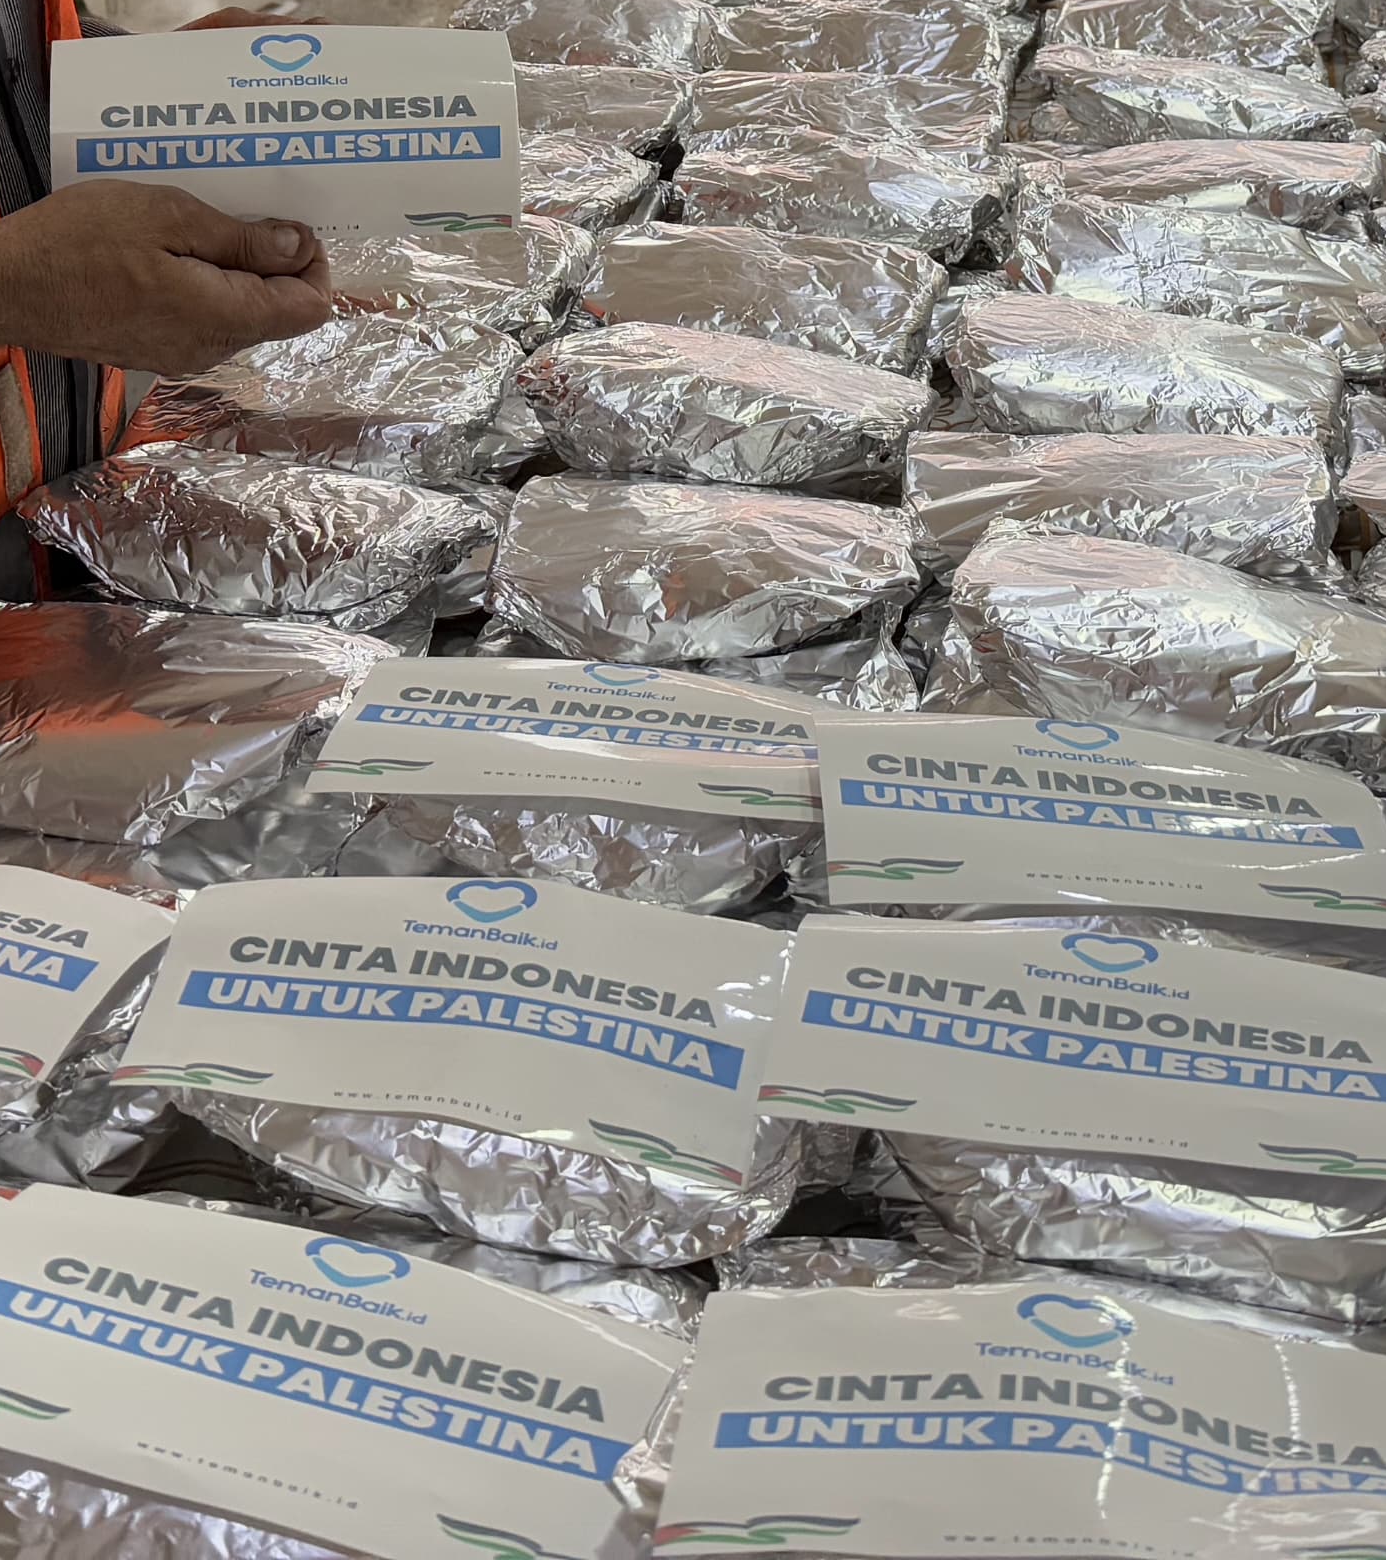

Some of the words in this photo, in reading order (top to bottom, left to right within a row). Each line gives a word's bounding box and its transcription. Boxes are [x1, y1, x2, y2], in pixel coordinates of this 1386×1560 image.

[227, 74, 348, 88] TemanBaik.id
[101, 102, 237, 128] CINTA
[245, 95, 477, 125] INDONESIA
[95, 138, 245, 167] UNTUK
[254, 132, 483, 162] PALESTINA
[547, 681, 676, 702] TemanBaik.id
[398, 687, 542, 715] CINTA
[550, 700, 811, 739] INDONESIA
[379, 708, 538, 735] UNTUK
[547, 721, 809, 757] PALESTINA
[1015, 744, 1161, 770] TemanBaik
[863, 784, 1048, 819] UNTUK
[867, 754, 1027, 788] CINTA
[1038, 771, 1322, 818] INDONESIA
[403, 920, 558, 952] TemanBaik.id
[229, 936, 398, 974] CINTA
[408, 953, 717, 1028] INDONESIA
[1022, 964, 1190, 1001] TemanBaik.id
[207, 978, 400, 1017] UNTUK
[405, 992, 715, 1076] PALESTINA
[845, 967, 1027, 1015] CINTA
[1038, 997, 1373, 1064] INDONESIA
[828, 999, 1035, 1058] UNTUK
[1042, 1041, 1380, 1098] PALESTINA
[333, 1089, 523, 1122] www.temanbaik.id
[249, 1268, 427, 1327] TemanBaik.id
[43, 1257, 235, 1329] CINTA
[247, 1306, 606, 1423] INDONESIA
[11, 1291, 232, 1375] UNTUK
[238, 1352, 598, 1474] PALESTINA
[764, 1374, 984, 1403] CINTA
[746, 1416, 994, 1444] UNTUK
